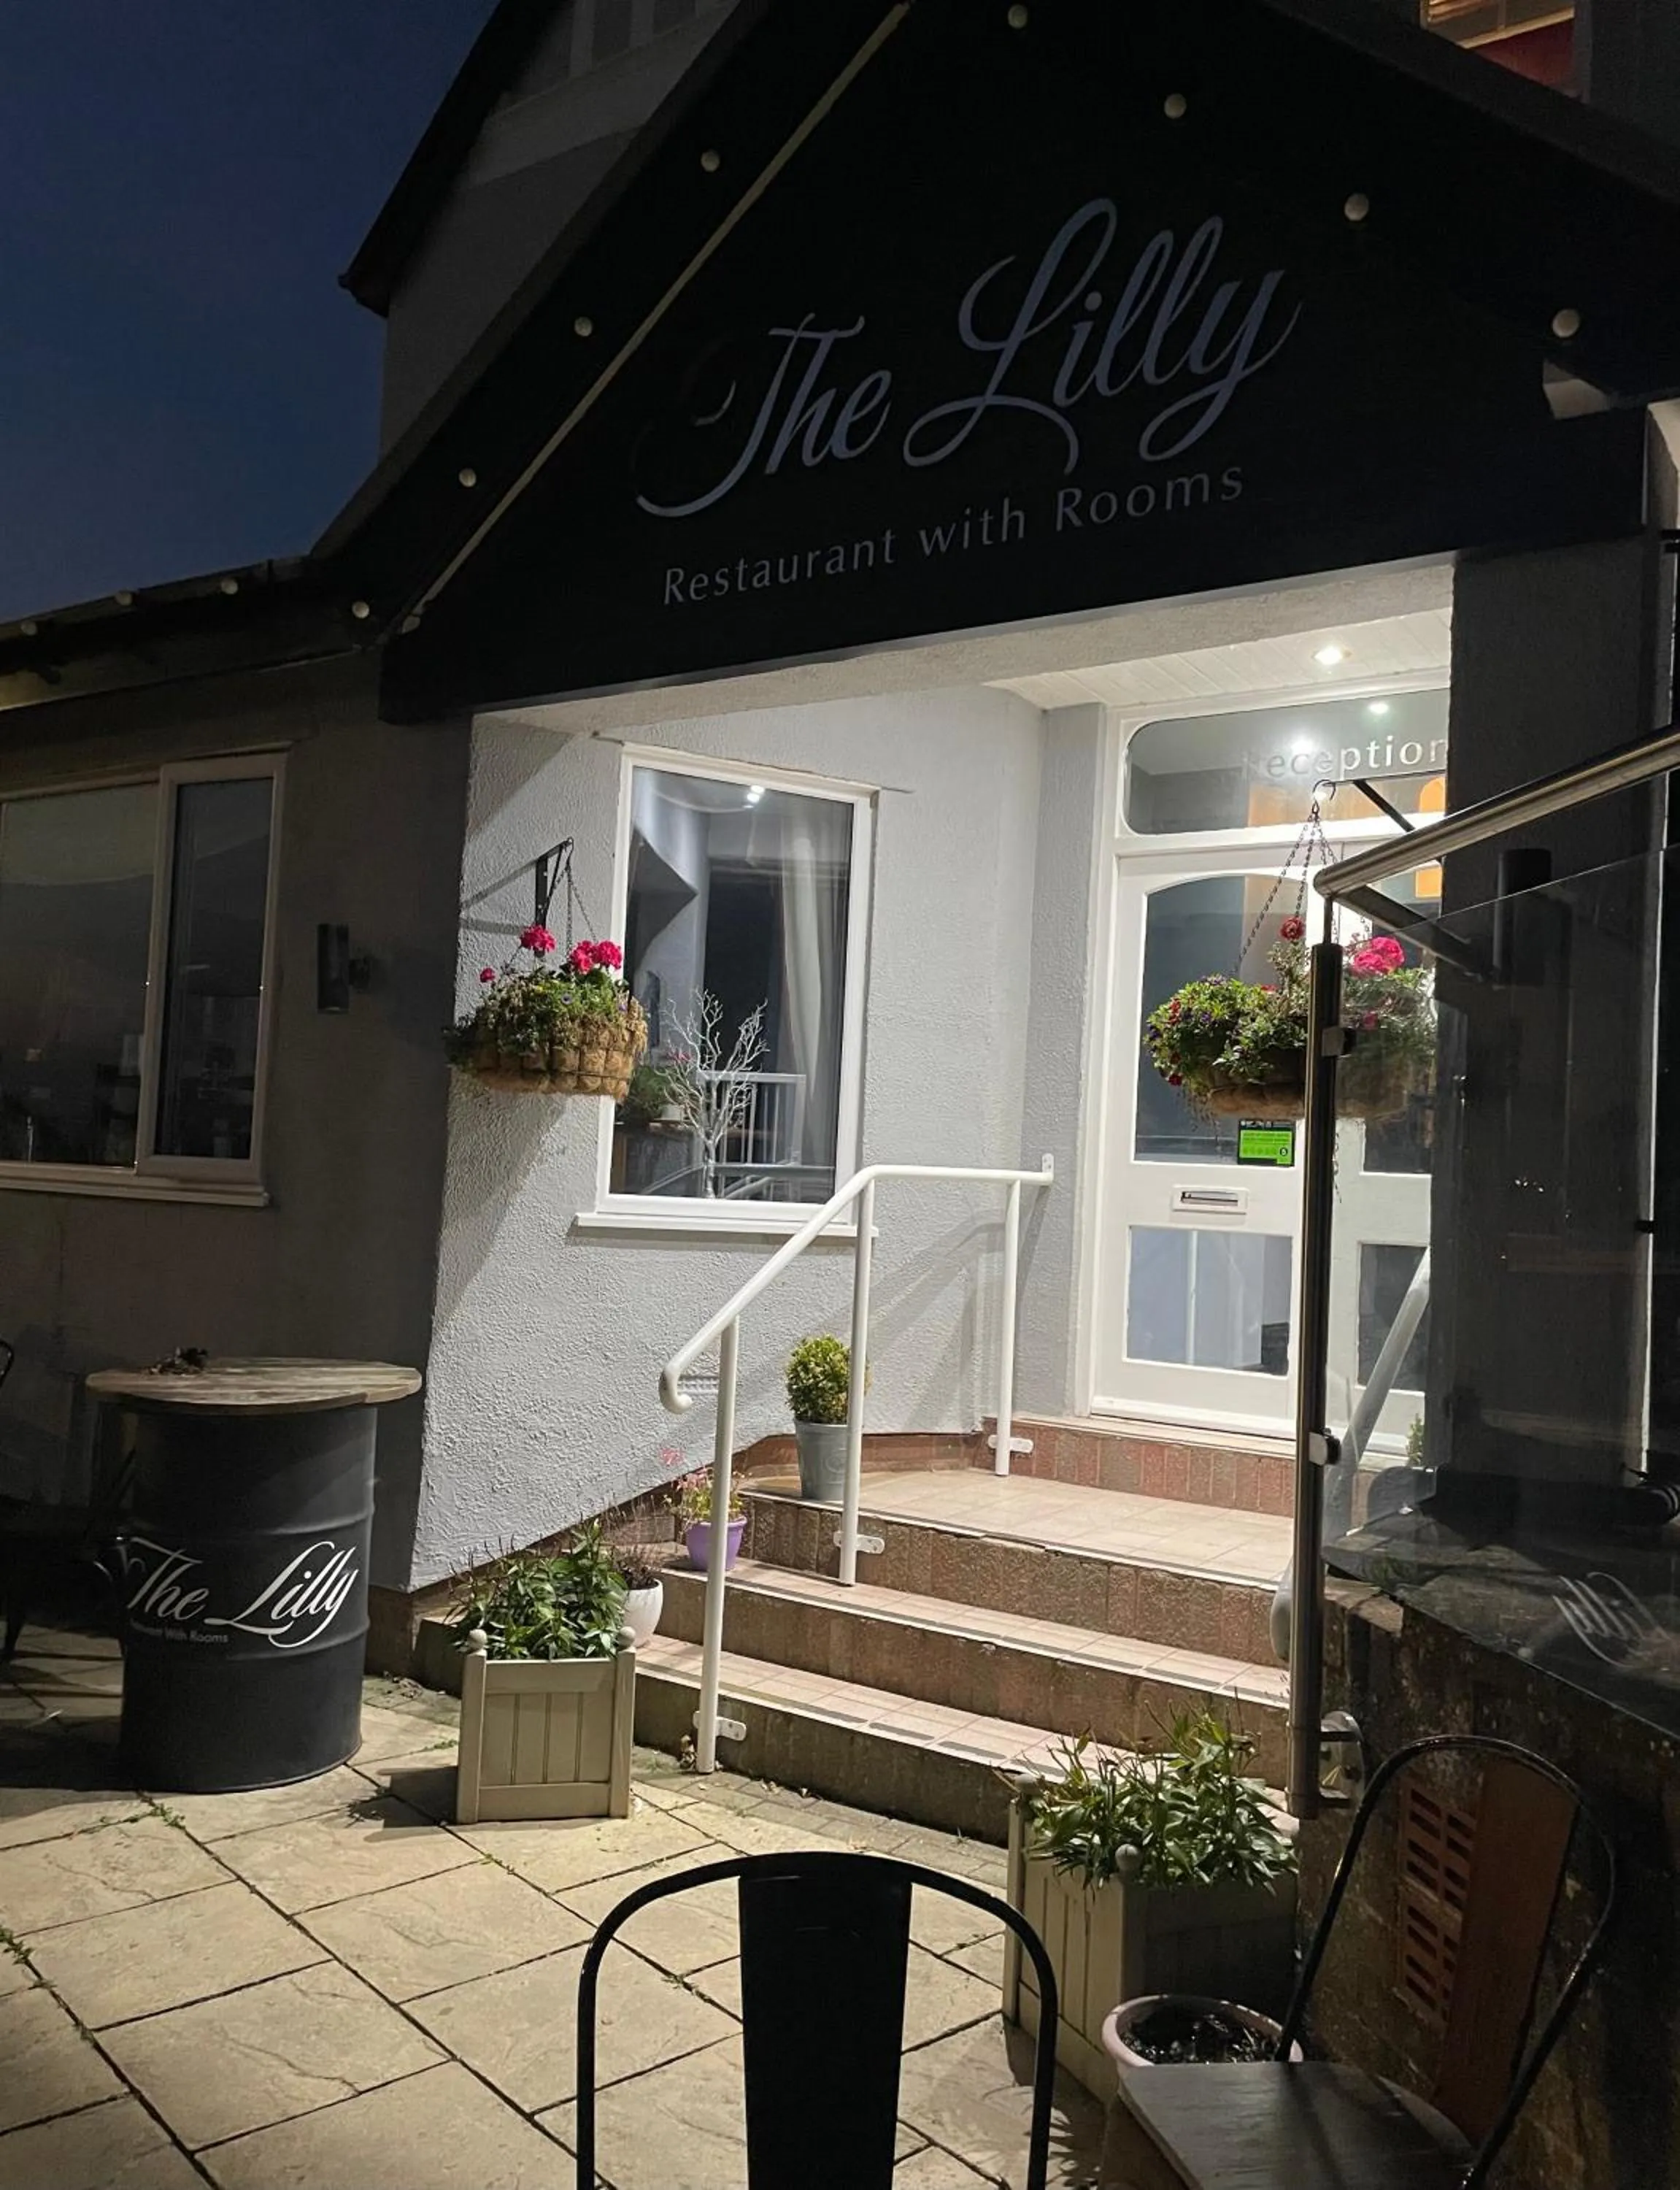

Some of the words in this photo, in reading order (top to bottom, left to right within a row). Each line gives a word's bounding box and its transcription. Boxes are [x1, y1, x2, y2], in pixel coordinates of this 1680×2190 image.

[635, 312, 893, 518] The
[902, 196, 1304, 474] Lilly
[663, 526, 896, 605] Restaurant
[919, 496, 1026, 557] with
[1055, 464, 1244, 531] Rooms
[127, 1537, 210, 1620] The
[204, 1541, 360, 1648] Lilly
